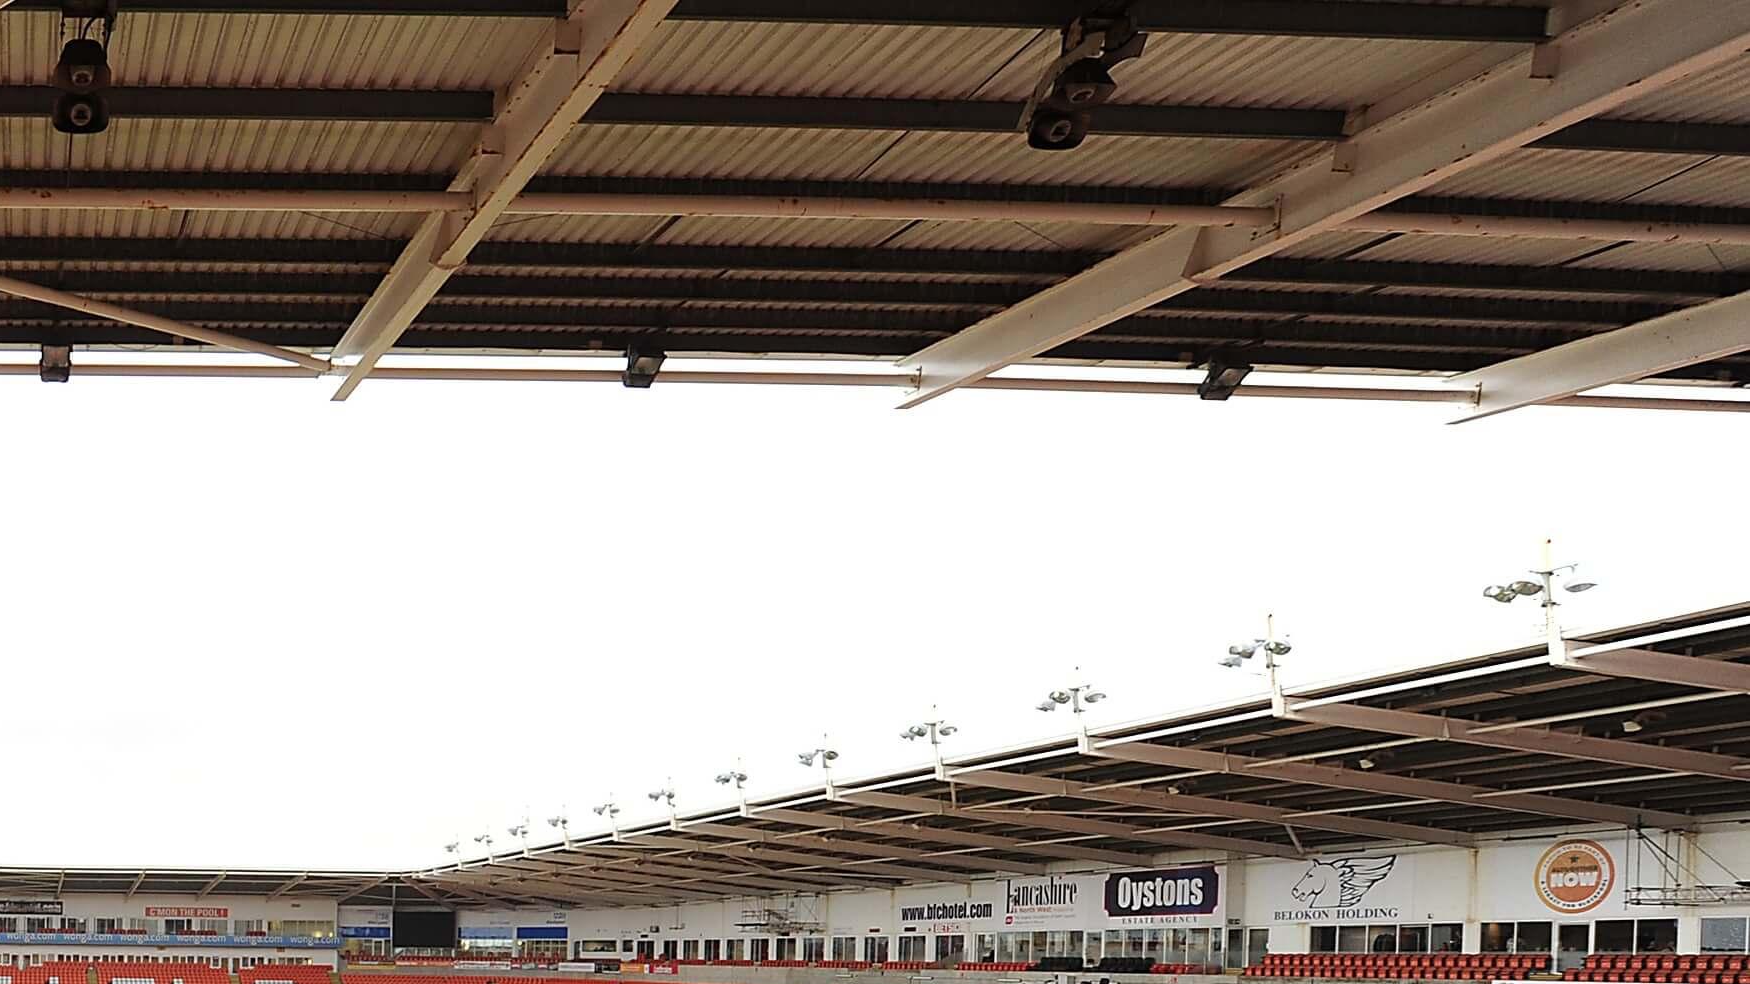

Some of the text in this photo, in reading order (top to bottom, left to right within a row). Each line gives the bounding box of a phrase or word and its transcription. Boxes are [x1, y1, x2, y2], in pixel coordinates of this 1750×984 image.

[1550, 872, 1598, 887] NOW
[1118, 876, 1204, 910] Oystons
[197, 909, 218, 917] POOL
[902, 902, 992, 920] www.bfchotel.com
[1274, 908, 1398, 921] BELOKON HOLDING
[63, 933, 113, 943] wonga.com
[177, 934, 226, 943] wonga.com
[290, 936, 339, 945] wonga.com
